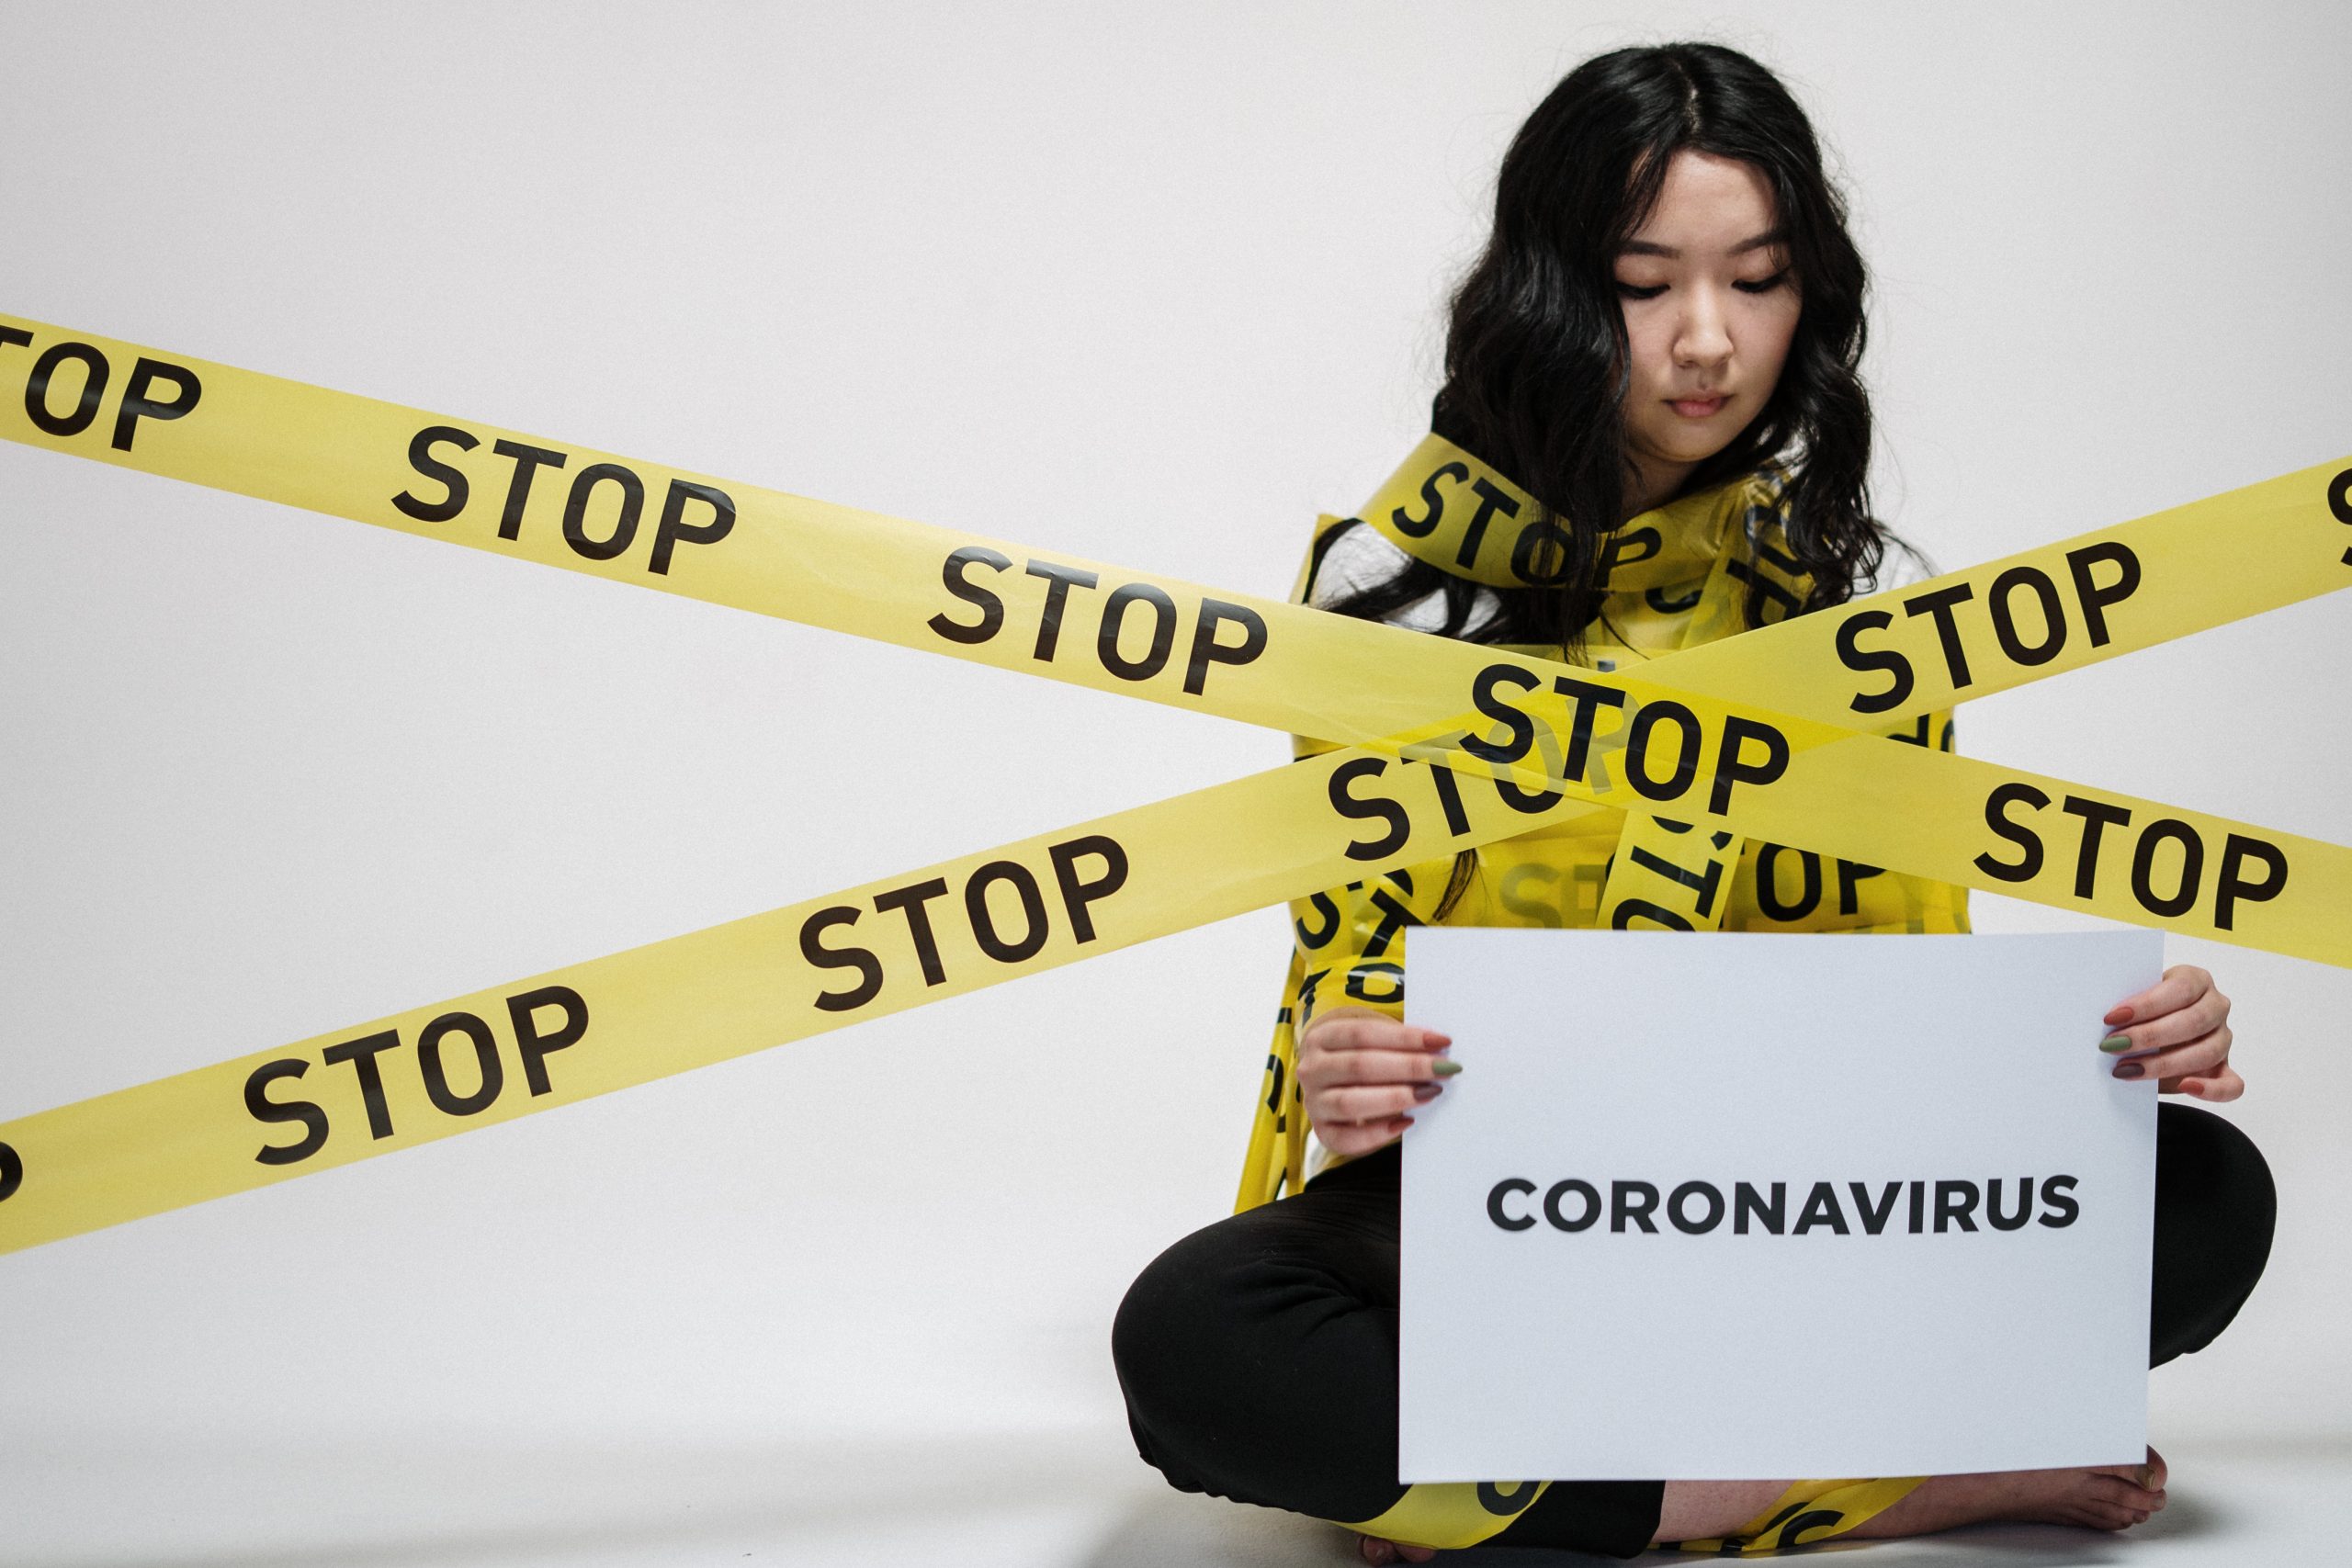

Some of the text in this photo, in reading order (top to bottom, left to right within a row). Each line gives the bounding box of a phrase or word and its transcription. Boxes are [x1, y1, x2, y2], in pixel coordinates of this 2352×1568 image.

[390, 425, 736, 576] STOP
[927, 545, 1268, 696] STOP
[1457, 663, 1790, 817] STOP
[1973, 783, 2289, 931] STOP
[1392, 461, 1662, 589] STOP
[243, 986, 589, 1166] STOP
[799, 835, 1129, 1012] STOP
[1835, 541, 2142, 714] STOP
[1487, 1174, 2080, 1235] CORONAVIRUS
